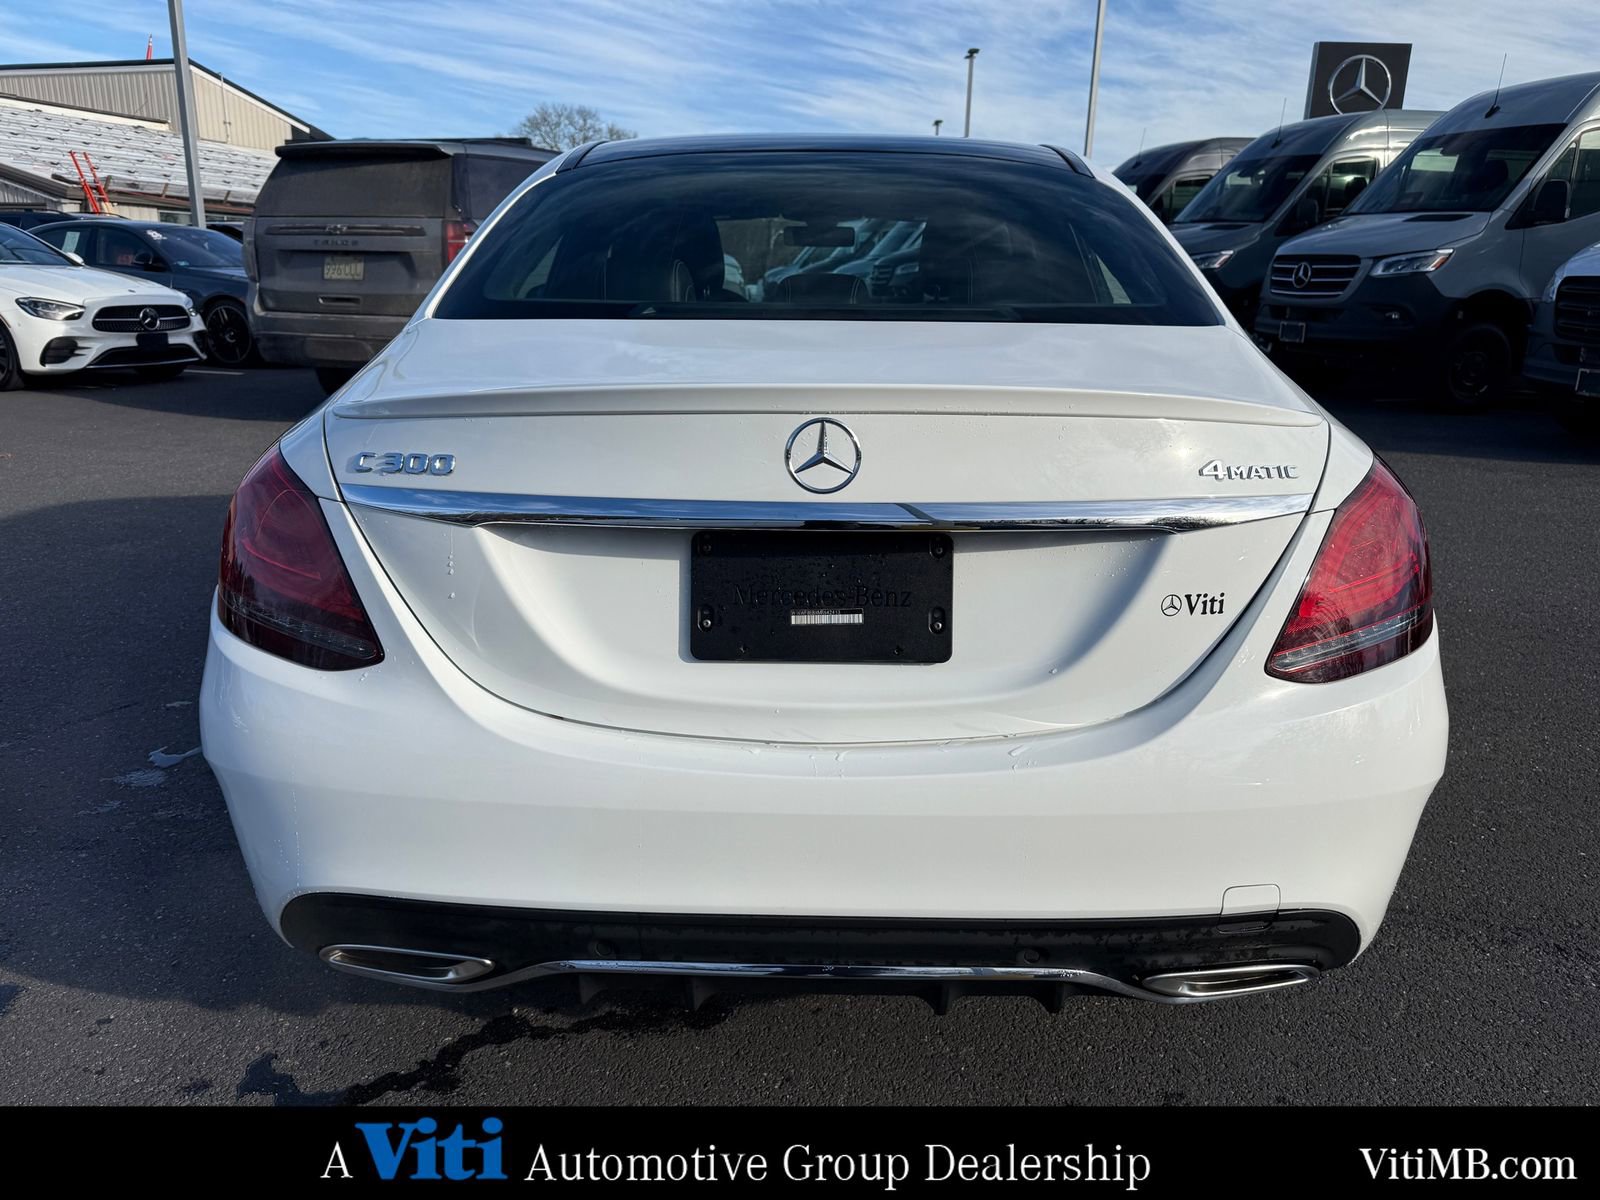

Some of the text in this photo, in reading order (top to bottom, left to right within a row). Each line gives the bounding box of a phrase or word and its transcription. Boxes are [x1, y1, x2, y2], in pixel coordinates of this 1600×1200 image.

[1198, 459, 1300, 482] 4MATIC
[732, 583, 912, 607] Mercedes-Benz
[1184, 592, 1225, 616] Viti
